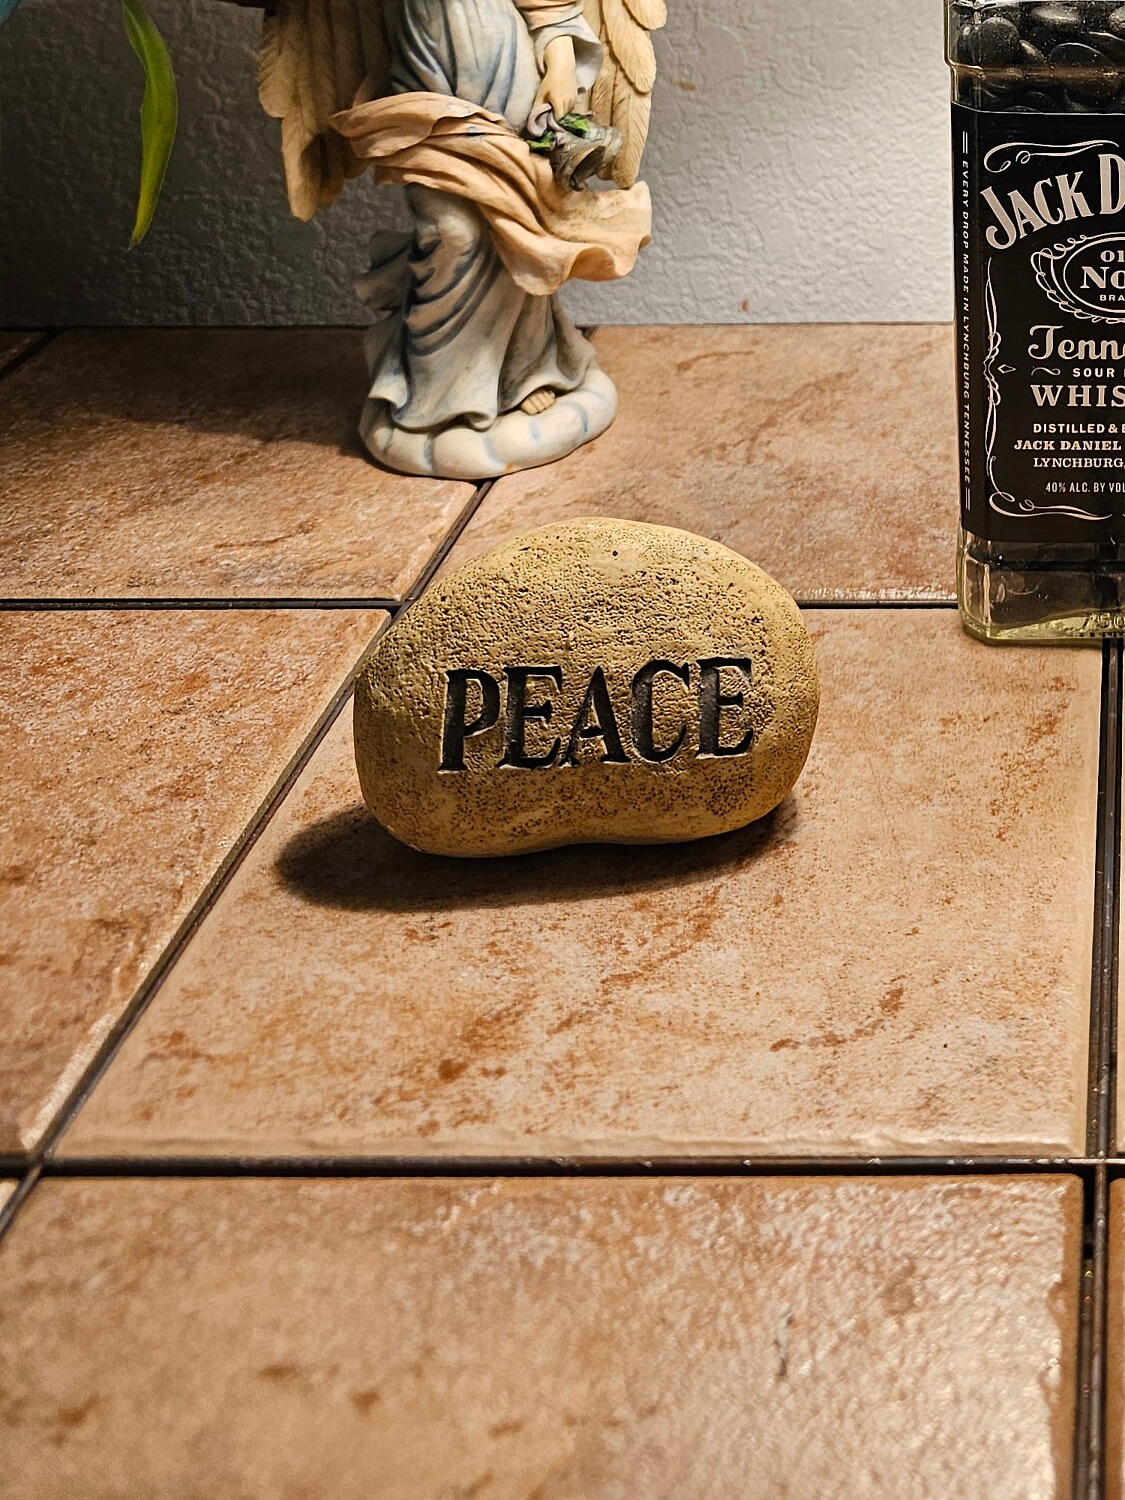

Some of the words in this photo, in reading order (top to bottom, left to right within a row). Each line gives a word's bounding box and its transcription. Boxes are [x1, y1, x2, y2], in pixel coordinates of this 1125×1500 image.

[962, 160, 970, 208] EVERY
[980, 170, 1095, 250] JACK
[962, 211, 970, 249] DROP
[962, 253, 970, 293] MADE
[963, 298, 970, 312] IN
[962, 316, 971, 399] LYNCHBURG
[1072, 367, 1115, 378] SOUR
[963, 403, 971, 484] TENNESSEE
[1014, 440, 1056, 451] JACK
[1060, 440, 1122, 451] DANIEL
[1033, 423, 1106, 434] DISTILLED
[1108, 423, 1119, 434] &
[1045, 481, 1067, 493] 40%
[1069, 482, 1091, 493] ALC.
[1093, 482, 1106, 493] BY
[437, 656, 756, 774] PEACE
